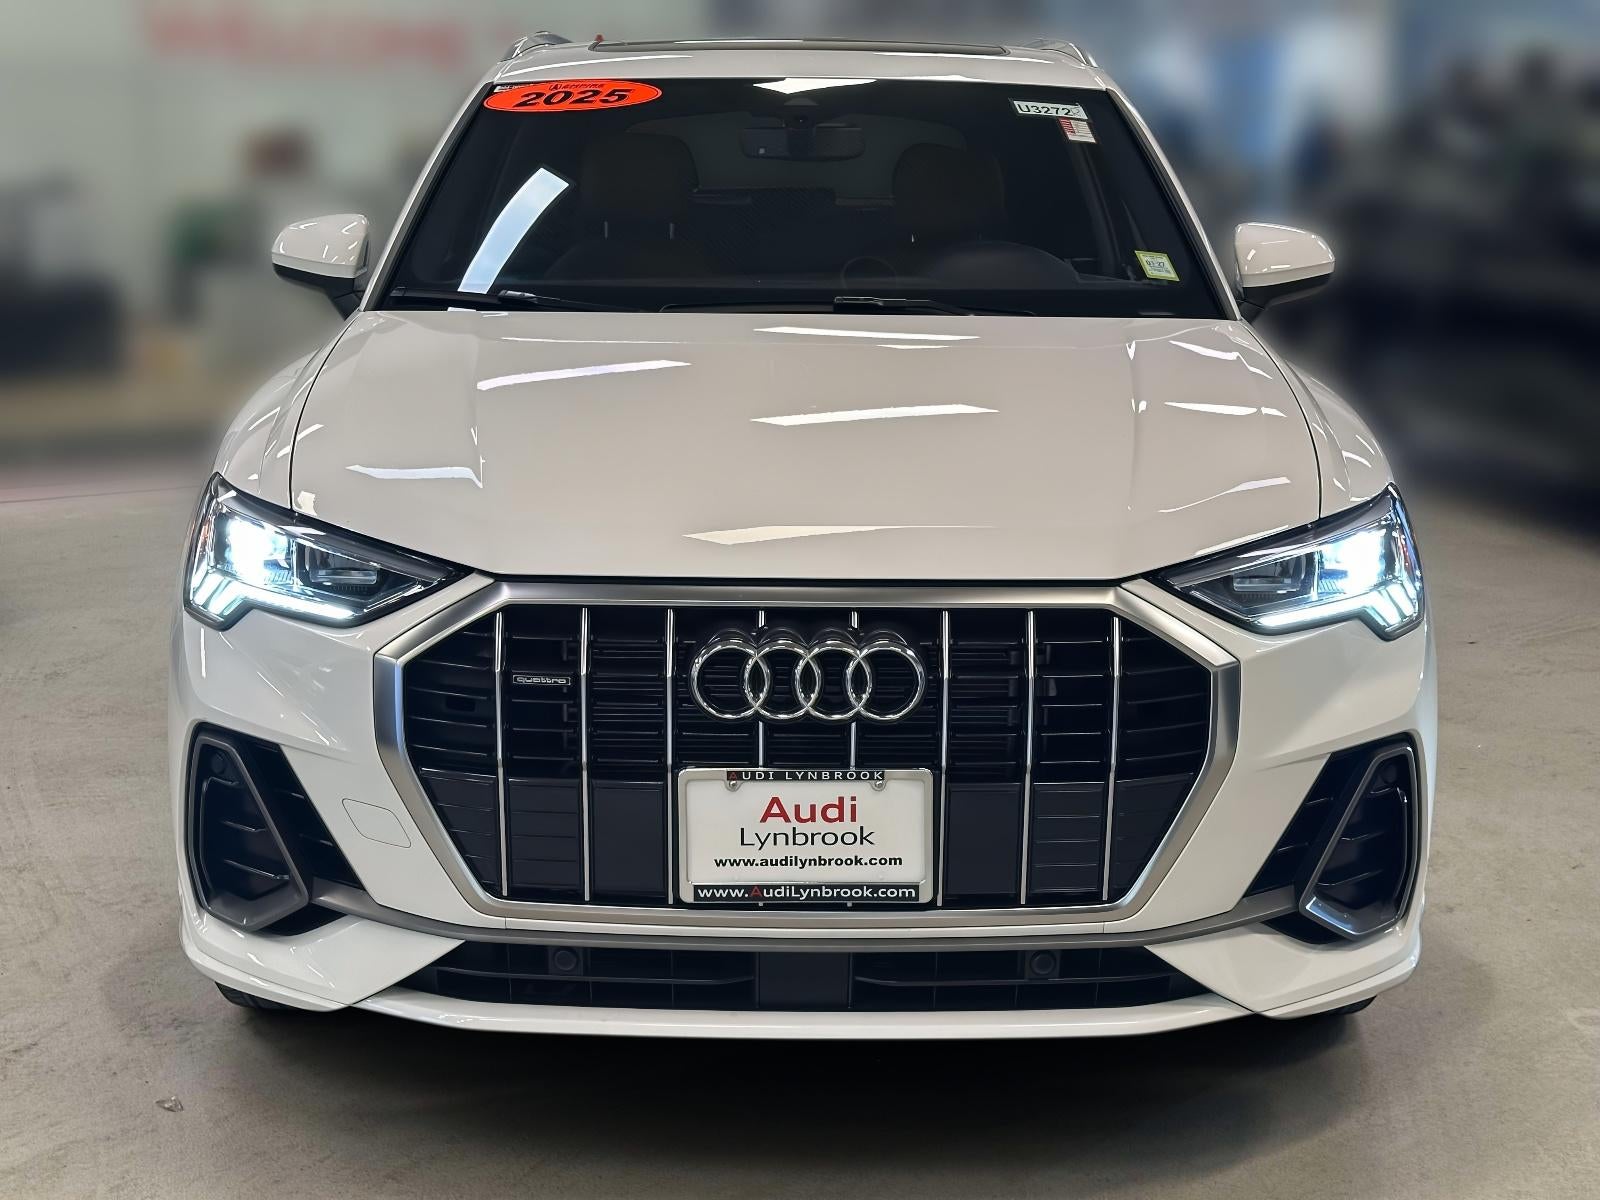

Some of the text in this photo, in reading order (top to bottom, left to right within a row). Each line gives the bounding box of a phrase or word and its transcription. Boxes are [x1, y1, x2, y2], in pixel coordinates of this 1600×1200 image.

[512, 89, 632, 108] 2025
[516, 676, 567, 684] quattro
[728, 771, 884, 780] AUDI LYNBROOK
[759, 795, 858, 824] Audi
[740, 825, 875, 850] Lynbrook
[713, 855, 903, 869] www.audilynbrook.com
[697, 885, 916, 900] www.AudiLynbrook.com
